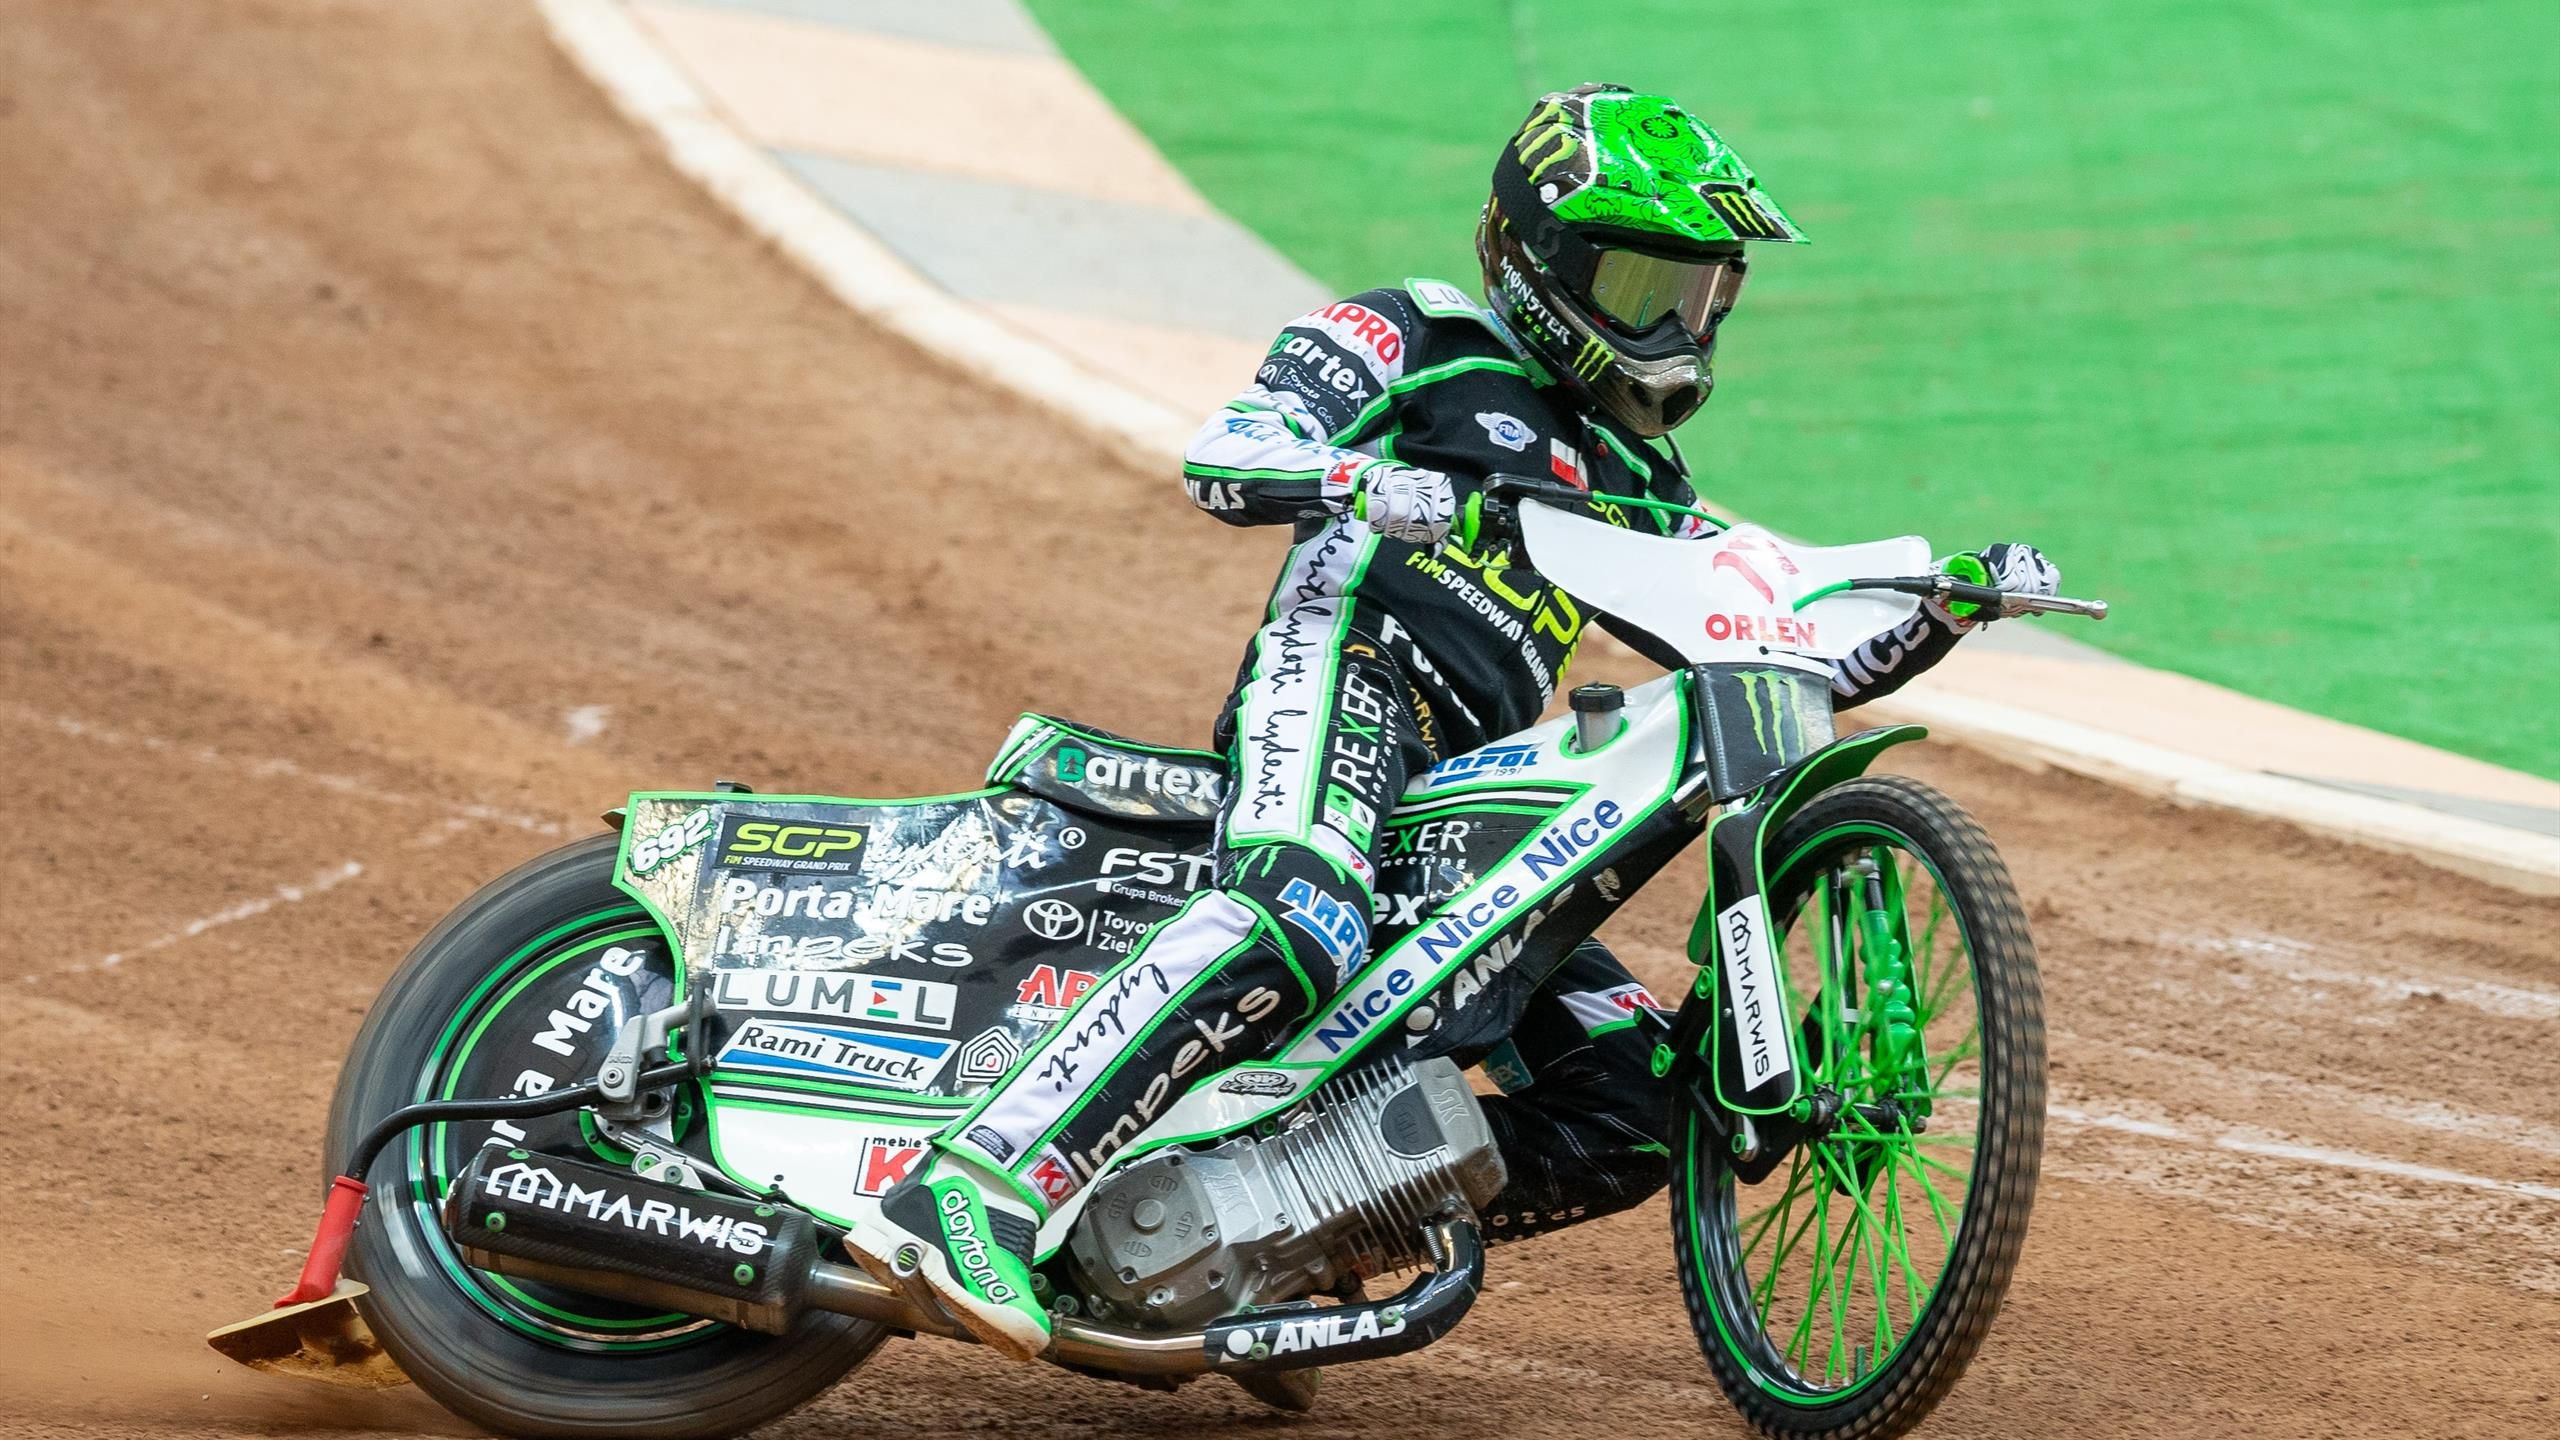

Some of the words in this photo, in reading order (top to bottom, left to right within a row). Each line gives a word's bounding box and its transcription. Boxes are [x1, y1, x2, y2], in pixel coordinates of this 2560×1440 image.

[1500, 255, 1569, 345] MONSTER
[1268, 332, 1369, 410] Bartex
[1287, 367, 1320, 399] Toyota
[1705, 613, 1816, 648] ORLEN
[1331, 673, 1382, 795] REXER
[1056, 747, 1223, 800] Bartex
[632, 808, 713, 872] 692
[728, 822, 862, 858] SGP
[741, 856, 793, 869] SPEEDWAY
[793, 860, 829, 871] GRAND
[827, 862, 852, 872] PRIX
[1100, 848, 1213, 892] FST
[1112, 883, 1147, 899] Grupa
[721, 877, 854, 921] Porta
[873, 883, 992, 926] Mare
[1315, 968, 1415, 1053] Nice
[1416, 884, 1519, 965] Nice
[1522, 799, 1624, 881] Nice
[531, 947, 646, 1057] Mare
[1737, 955, 1770, 1077] MARWIS
[738, 1026, 827, 1058] Rami
[835, 1042, 926, 1081] Truck
[1070, 985, 1281, 1181] Impeks
[873, 1137, 922, 1148] meble
[562, 1182, 769, 1255] MARWIS
[940, 1189, 1018, 1305] daytona
